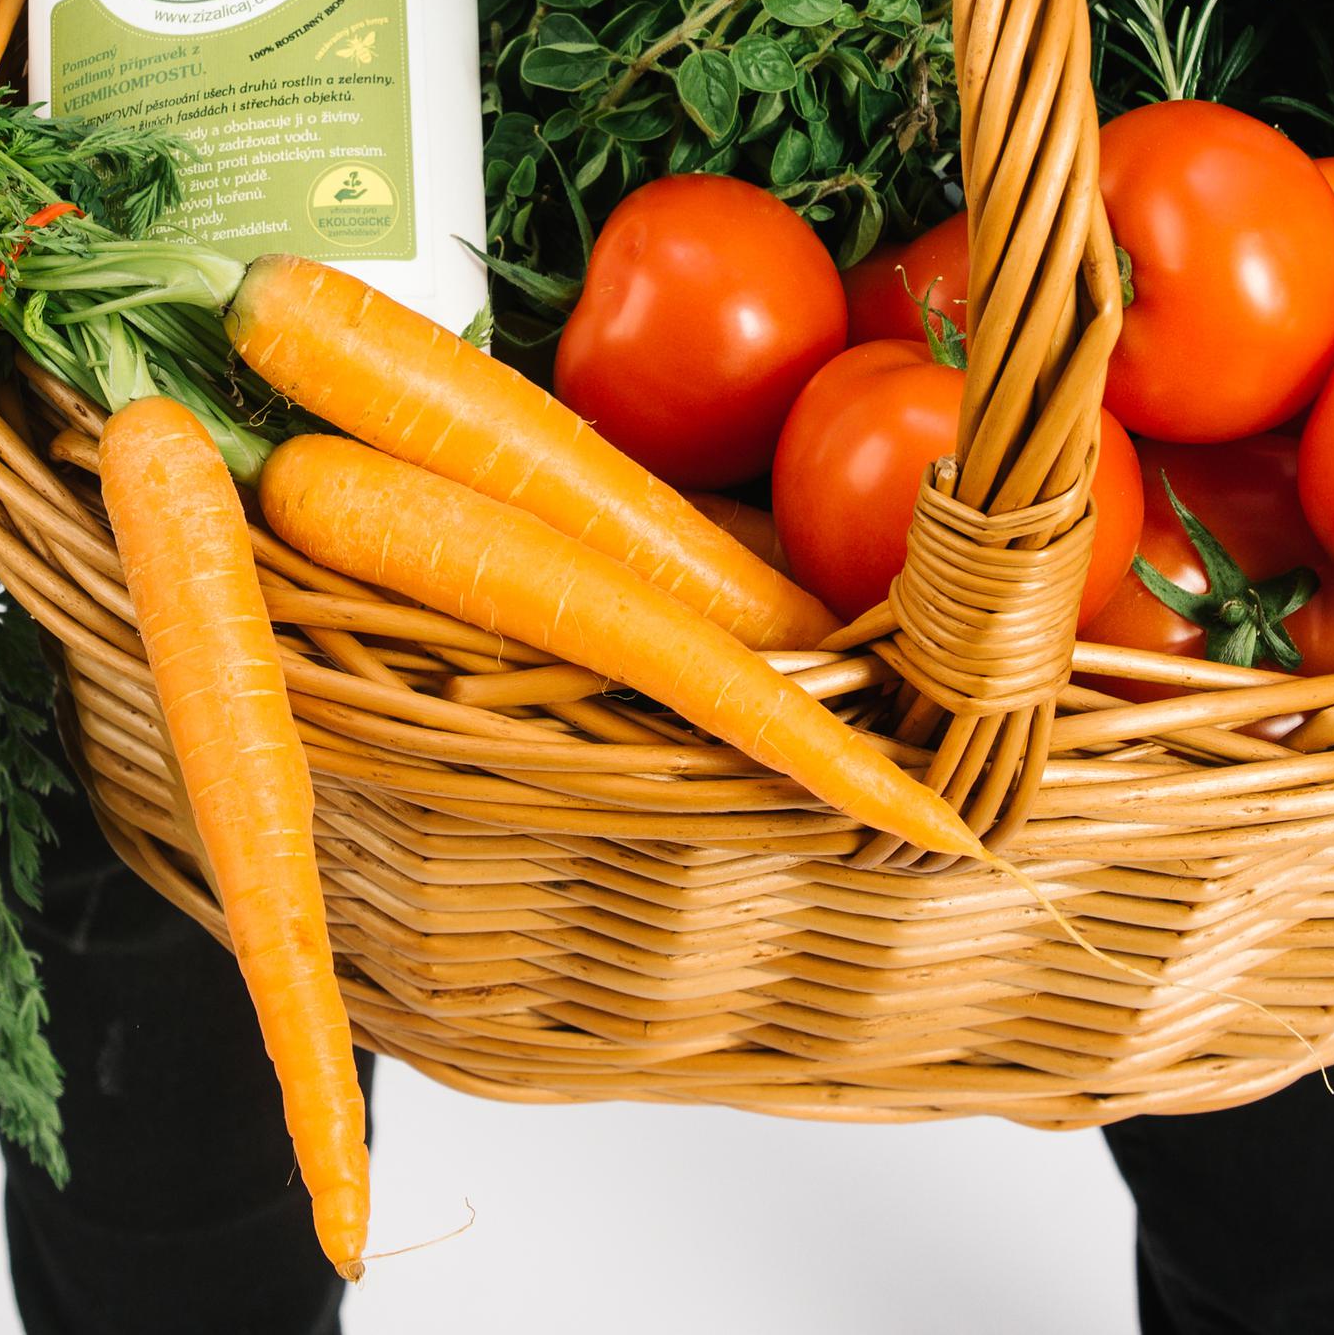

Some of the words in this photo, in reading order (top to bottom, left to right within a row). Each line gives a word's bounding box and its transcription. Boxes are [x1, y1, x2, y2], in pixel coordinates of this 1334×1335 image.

[249, 46, 274, 62] 100%
[275, 12, 325, 49] ROSTLINNÝ
[61, 43, 118, 76] Pomocný
[62, 66, 117, 94] rostlinný
[119, 45, 187, 75] přípravek
[192, 45, 201, 55] z
[239, 78, 278, 94] druhů
[282, 75, 322, 89] rostlin
[326, 77, 334, 85] a
[338, 73, 395, 86] zeleniny.
[176, 102, 228, 125] fasádách
[240, 92, 299, 111] střechách
[185, 125, 208, 141] ůdy
[212, 127, 219, 136] a
[224, 115, 291, 134] obohacuje
[308, 115, 317, 124] o
[321, 110, 364, 125] živiny.
[219, 133, 281, 152] zadržovat
[285, 129, 321, 144] vodu.
[218, 154, 247, 173] proti
[252, 146, 325, 165] abiotickým
[329, 144, 387, 158] stresům.
[190, 177, 219, 193] život
[223, 177, 231, 186] v
[180, 194, 212, 213] vývoj
[212, 218, 292, 241] zemědělství.
[318, 215, 392, 228] EKOLOGICKÉ
